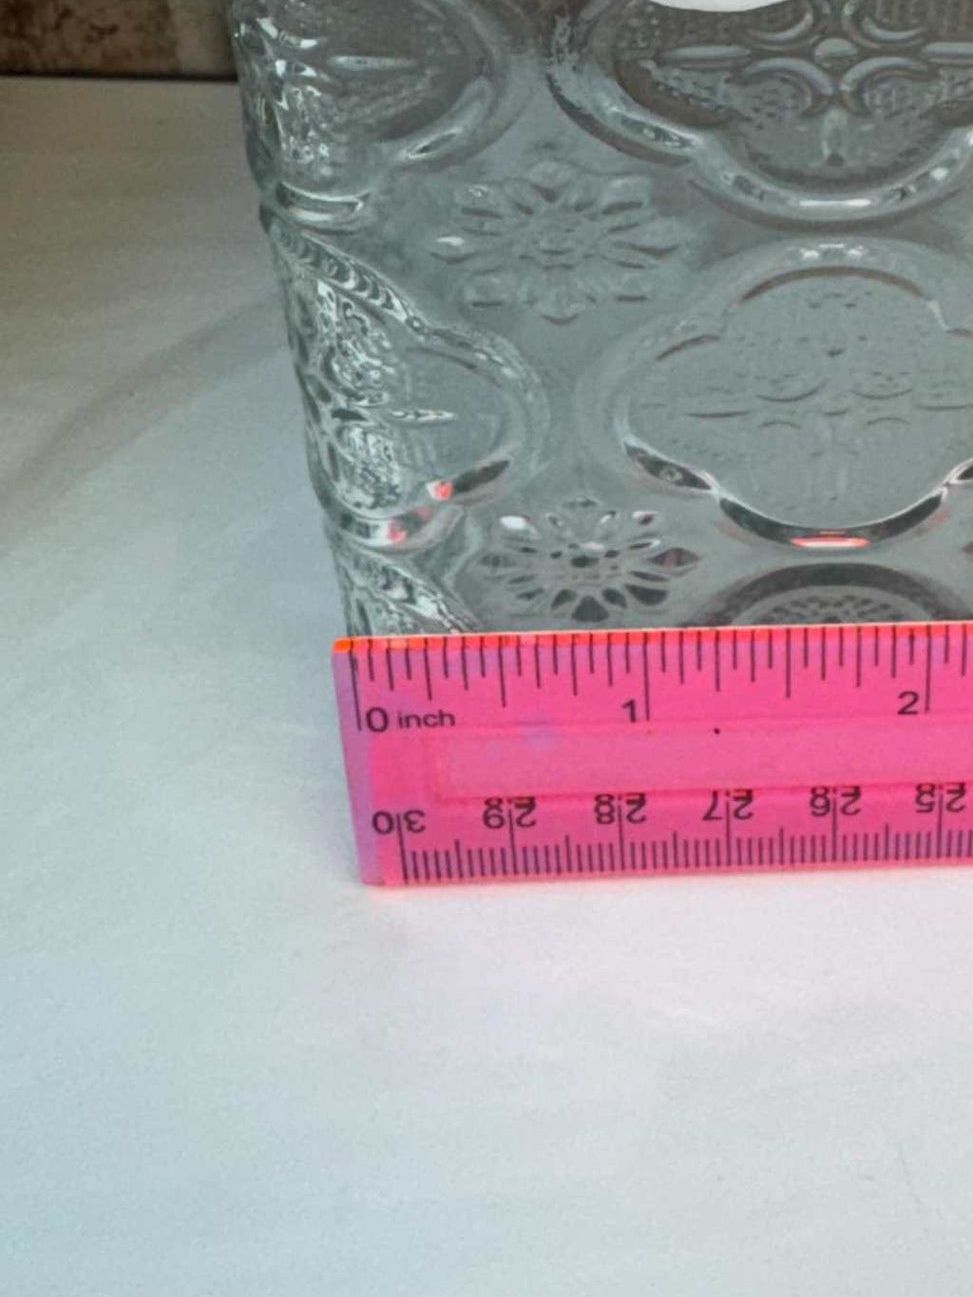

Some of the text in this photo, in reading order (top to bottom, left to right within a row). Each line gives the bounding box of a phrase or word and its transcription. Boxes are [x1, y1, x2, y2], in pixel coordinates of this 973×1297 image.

[366, 707, 389, 733] 0
[398, 709, 456, 729] inch
[622, 699, 638, 723] 1
[897, 691, 920, 715] 2
[482, 796, 538, 829] 29
[594, 792, 648, 825] 28
[702, 788, 754, 821] 27
[809, 785, 862, 817] 26
[915, 782, 967, 813] 25
[372, 809, 426, 835] 30
